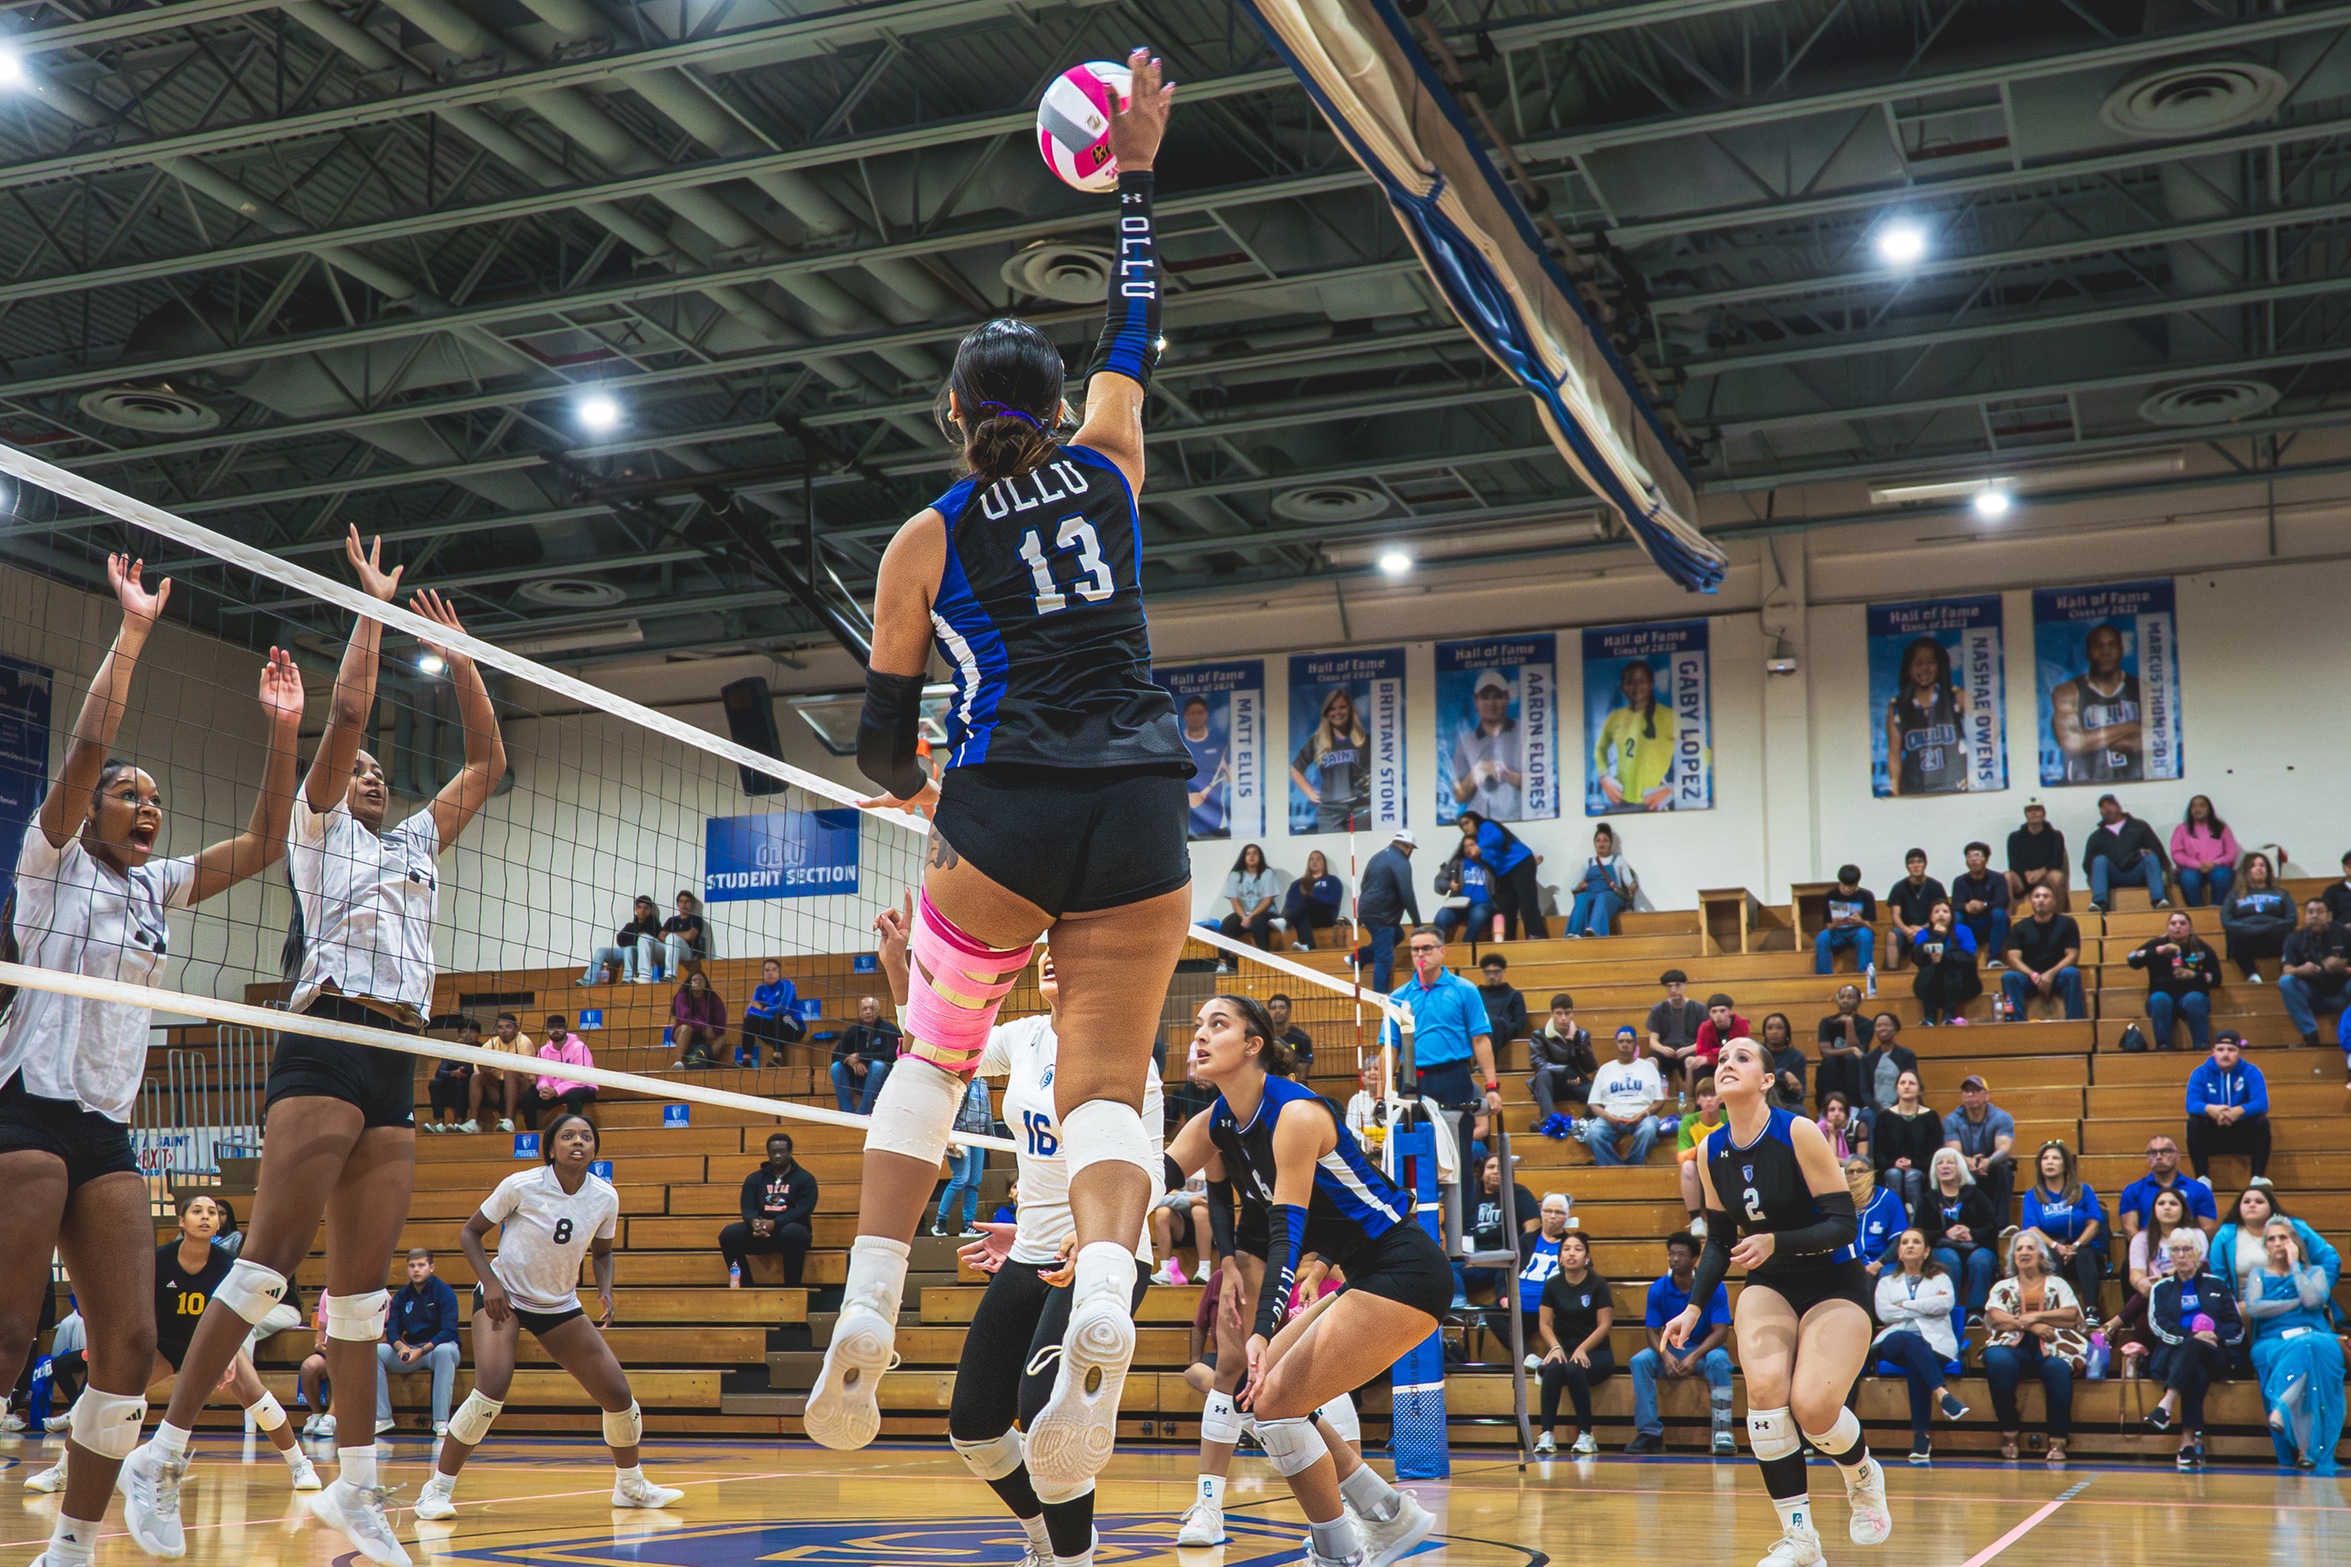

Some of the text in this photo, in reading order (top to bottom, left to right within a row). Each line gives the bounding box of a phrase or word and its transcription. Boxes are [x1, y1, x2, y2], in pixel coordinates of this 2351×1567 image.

[1121, 216, 1155, 300] OLLU
[980, 460, 1089, 520] OLLU
[1018, 514, 1116, 616] 13
[2056, 590, 2151, 609] Hall of Fame
[1890, 605, 1979, 625] Hall of Fame
[1455, 643, 1535, 661] Hall of Fame
[1604, 630, 1687, 648] Hall of Fame
[1170, 670, 1245, 685] Hall of Fame
[1308, 658, 1385, 674] Hall of Fame
[1972, 636, 1994, 780] NASHAE OWENS
[2148, 621, 2167, 769] MARCUS THOMPSON
[1528, 672, 1545, 810] AARON FLORES
[1679, 660, 1701, 800] GABY LOPEZ
[1237, 698, 1252, 798] MATT ELLIS
[1380, 683, 1395, 822] BRITTANY STONE
[1625, 738, 1636, 758] 2
[706, 865, 857, 890] STUDENT SECTION
[1610, 1080, 1643, 1093] OLLU
[1023, 1110, 1058, 1156] 16
[142, 1148, 169, 1169] EXT
[1743, 1187, 1767, 1222] 2
[553, 1218, 573, 1244] 8
[176, 1292, 206, 1315] 10
